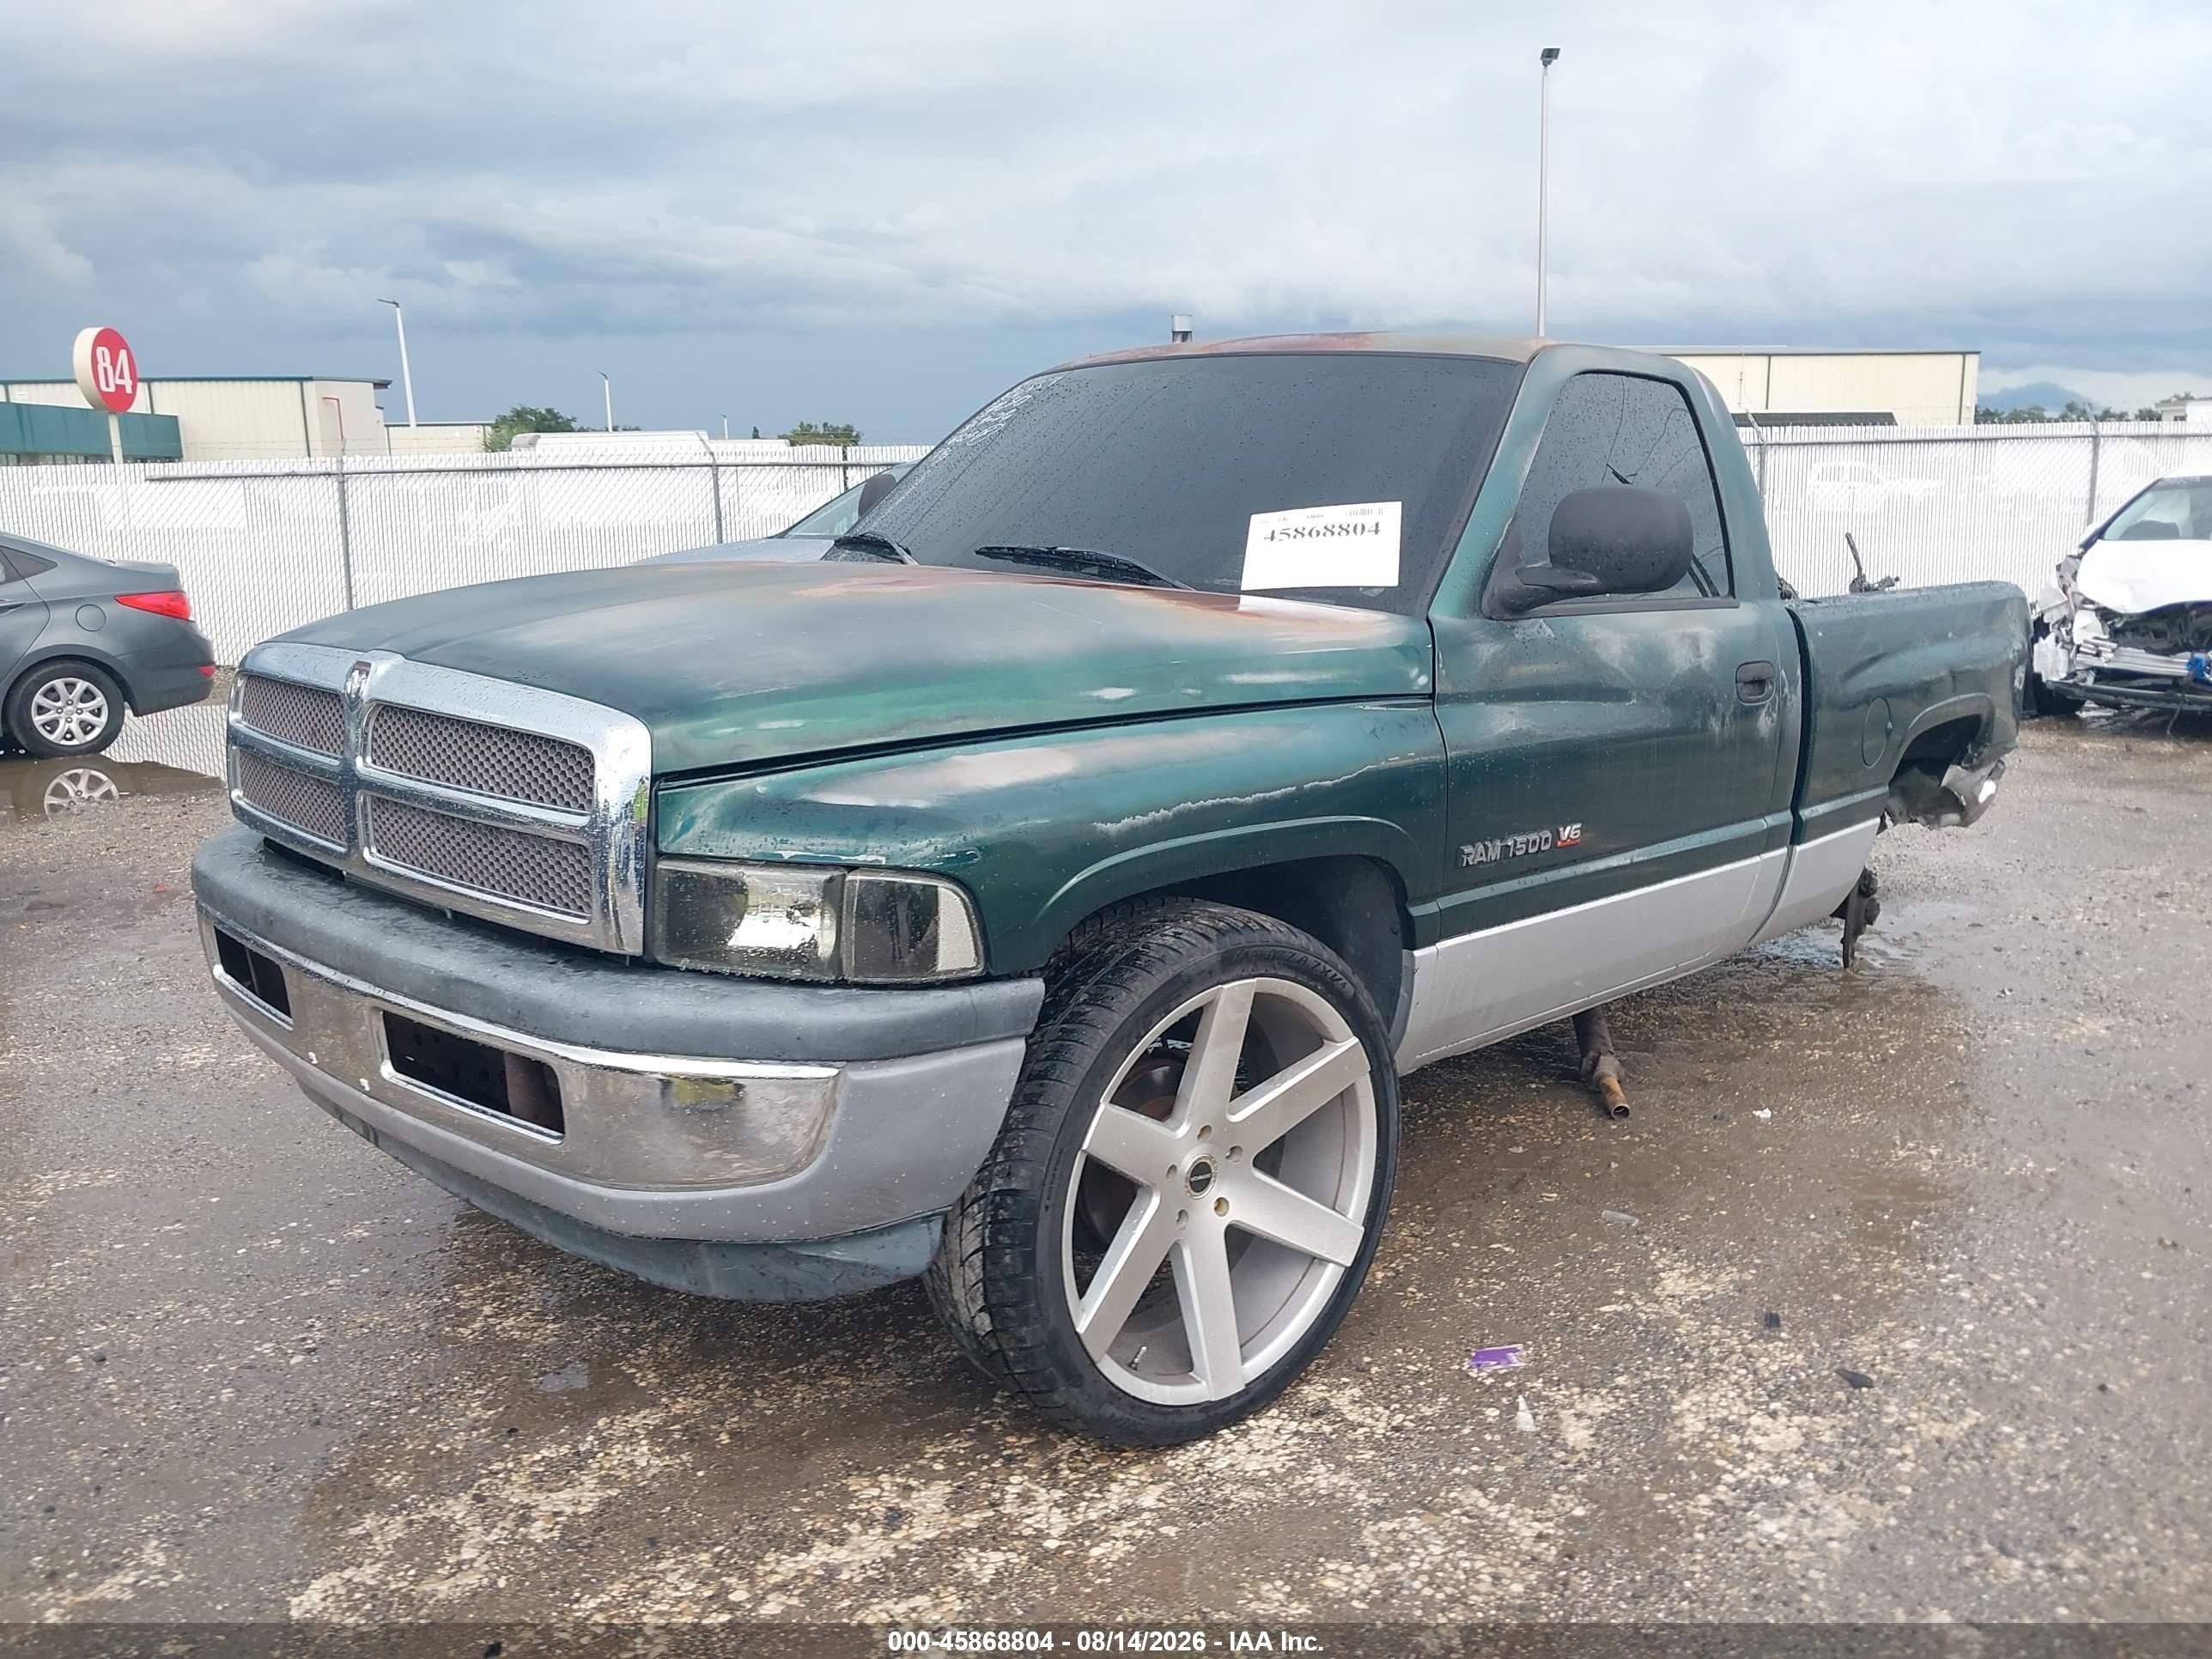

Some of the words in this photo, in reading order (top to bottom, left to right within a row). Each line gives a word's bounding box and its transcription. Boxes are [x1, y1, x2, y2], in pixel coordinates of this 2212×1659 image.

[95, 346, 133, 394] 84
[1263, 520, 1382, 542] 45868804
[1460, 838, 1503, 867] RAM
[1503, 830, 1553, 858] 1500
